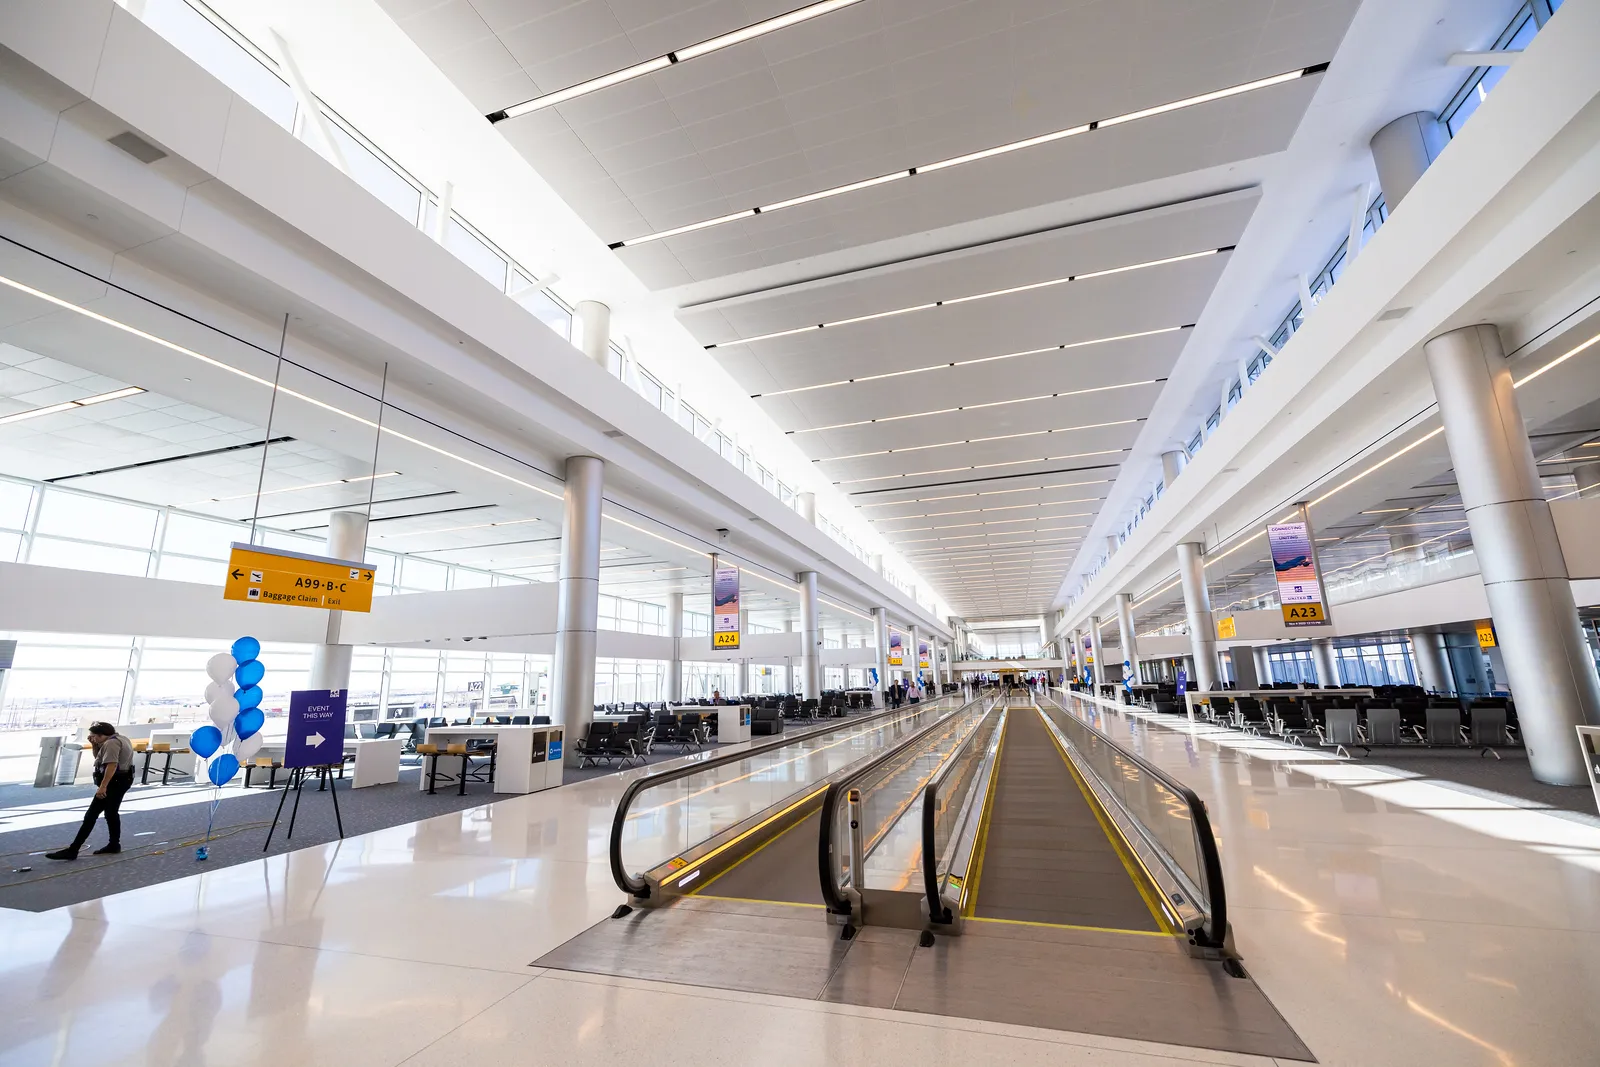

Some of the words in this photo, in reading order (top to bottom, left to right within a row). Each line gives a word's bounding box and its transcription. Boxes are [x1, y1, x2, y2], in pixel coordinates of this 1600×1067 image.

[263, 591, 296, 601] Baggage
[298, 594, 318, 603] Claim
[327, 597, 341, 605] Exit
[1290, 607, 1317, 618] A23
[718, 635, 736, 643] A24
[1480, 633, 1493, 642] A23
